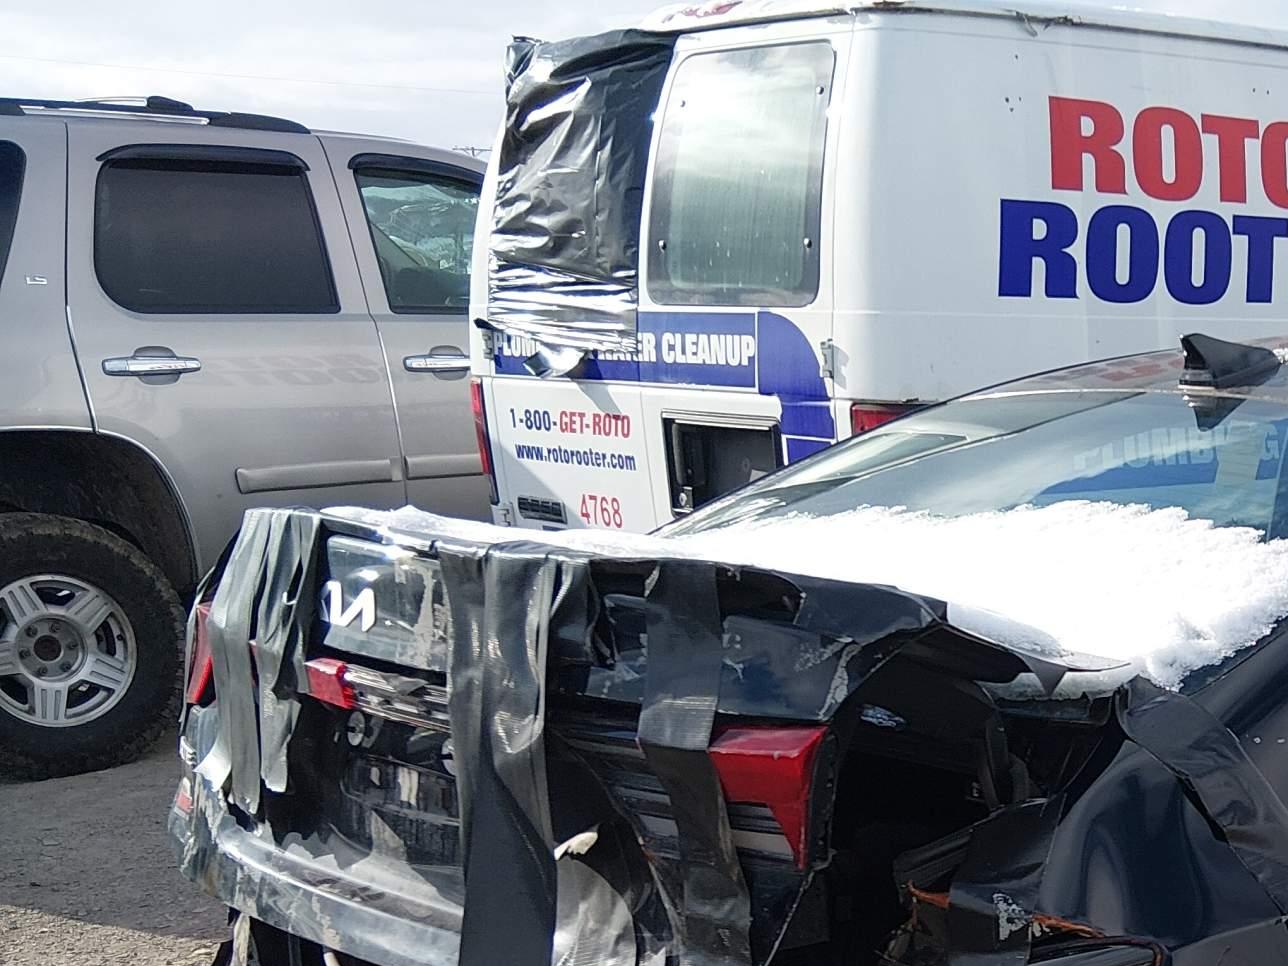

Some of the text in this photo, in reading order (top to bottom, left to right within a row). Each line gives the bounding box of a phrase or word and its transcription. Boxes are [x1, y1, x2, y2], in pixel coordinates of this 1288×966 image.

[661, 332, 756, 366] CLEANUP
[510, 408, 631, 438] 1-800-GET-ROTO
[515, 443, 637, 471] www.rotorooter.com
[580, 493, 623, 529] 4768
